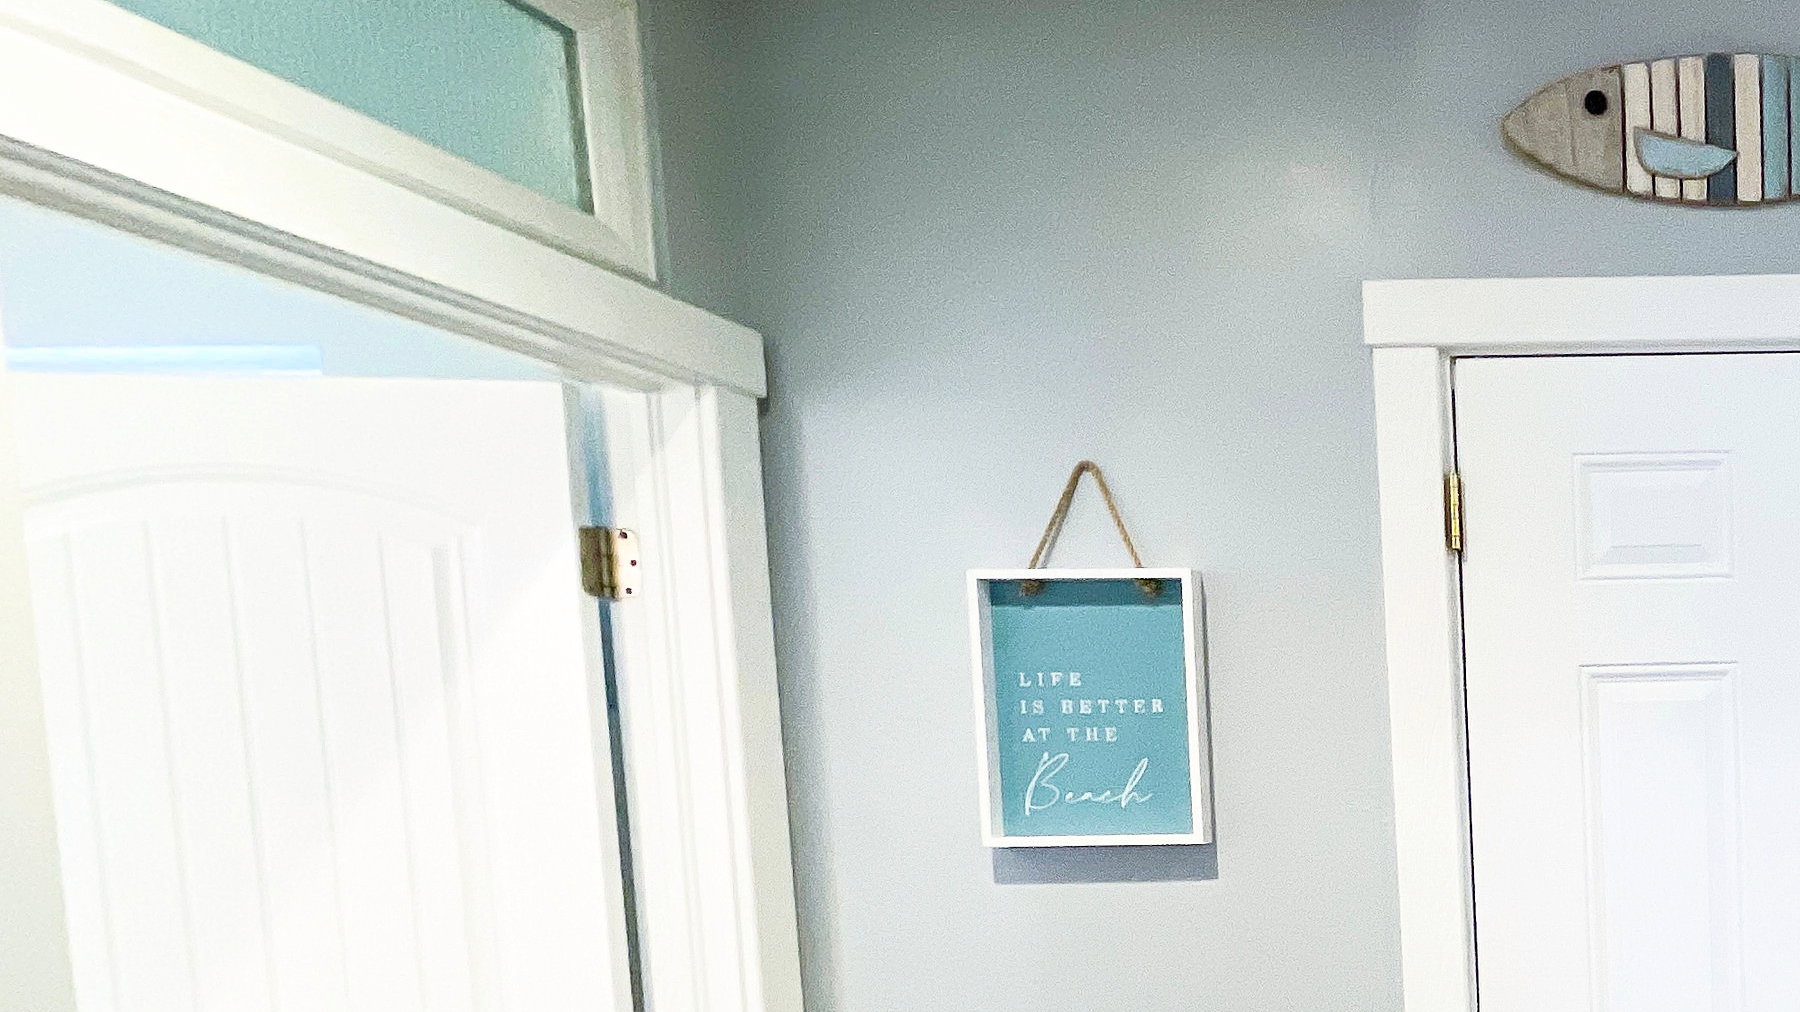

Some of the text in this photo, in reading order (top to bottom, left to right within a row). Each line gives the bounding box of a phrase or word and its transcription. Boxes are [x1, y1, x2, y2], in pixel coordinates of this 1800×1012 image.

[1019, 672, 1082, 687] LIFE
[1020, 698, 1164, 715] IS BETTER
[1022, 726, 1118, 743] AT THE
[1024, 751, 1153, 816] Beach
